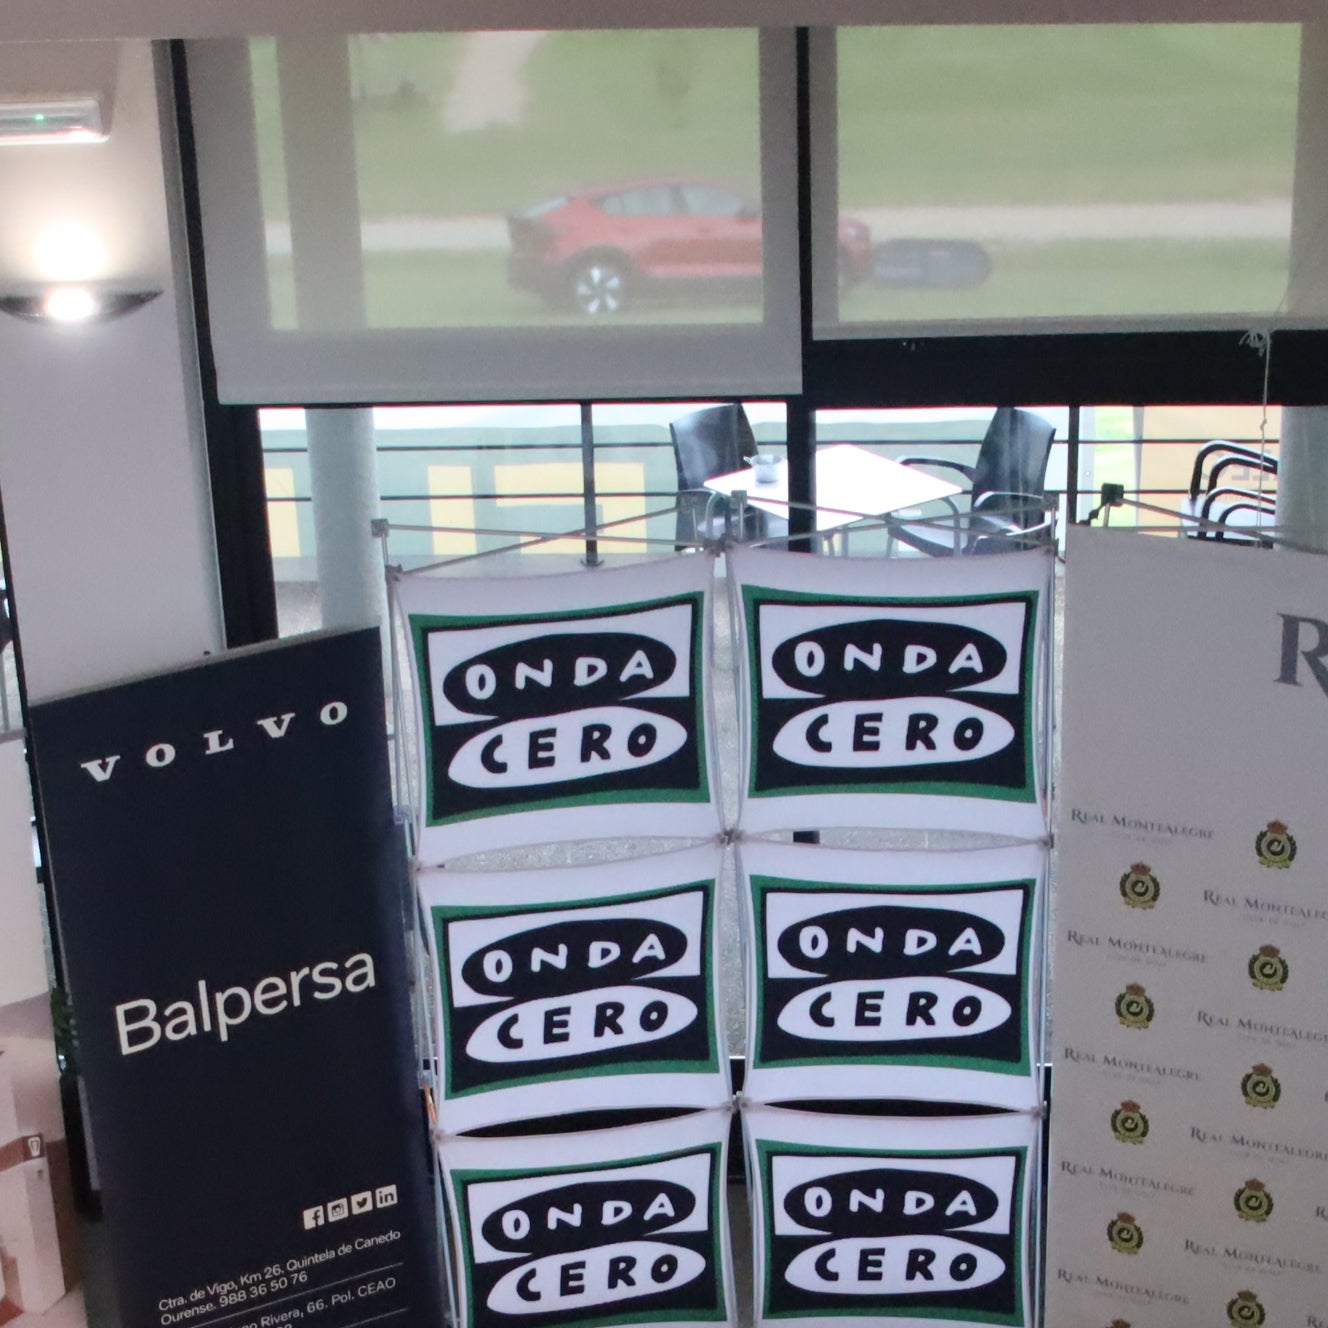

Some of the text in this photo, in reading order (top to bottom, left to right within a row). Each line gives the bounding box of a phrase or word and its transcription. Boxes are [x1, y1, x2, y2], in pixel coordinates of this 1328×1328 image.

[465, 650, 655, 701] ONDA
[794, 640, 986, 679] ONDA
[81, 701, 348, 782] VOLVO
[480, 720, 659, 775] CERO
[805, 712, 986, 754] CERO
[1071, 808, 1215, 838] REAL MONTEALEGRE
[1203, 889, 1236, 907] REAL
[482, 933, 668, 985] ONDA
[798, 927, 984, 964] ONDA
[115, 952, 376, 1056] Balpersa
[495, 1000, 669, 1051] CERO
[808, 990, 984, 1029] CERO
[1197, 1010, 1229, 1028] REAL
[1064, 1047, 1095, 1064] REAL
[501, 1192, 676, 1241] ONDA
[803, 1188, 979, 1219] ONDA
[158, 1227, 401, 1312] Ctra. de Vigo, Km 26. Quintela de Canedo
[515, 1253, 680, 1303] CERO
[813, 1248, 977, 1284] CERO
[160, 1270, 308, 1326] Ourense. 988 36 50 76
[260, 1305, 304, 1328] Rivera,
[306, 1297, 327, 1314] 66.
[331, 1289, 354, 1306] Pol.
[357, 1276, 396, 1298] CEAO
